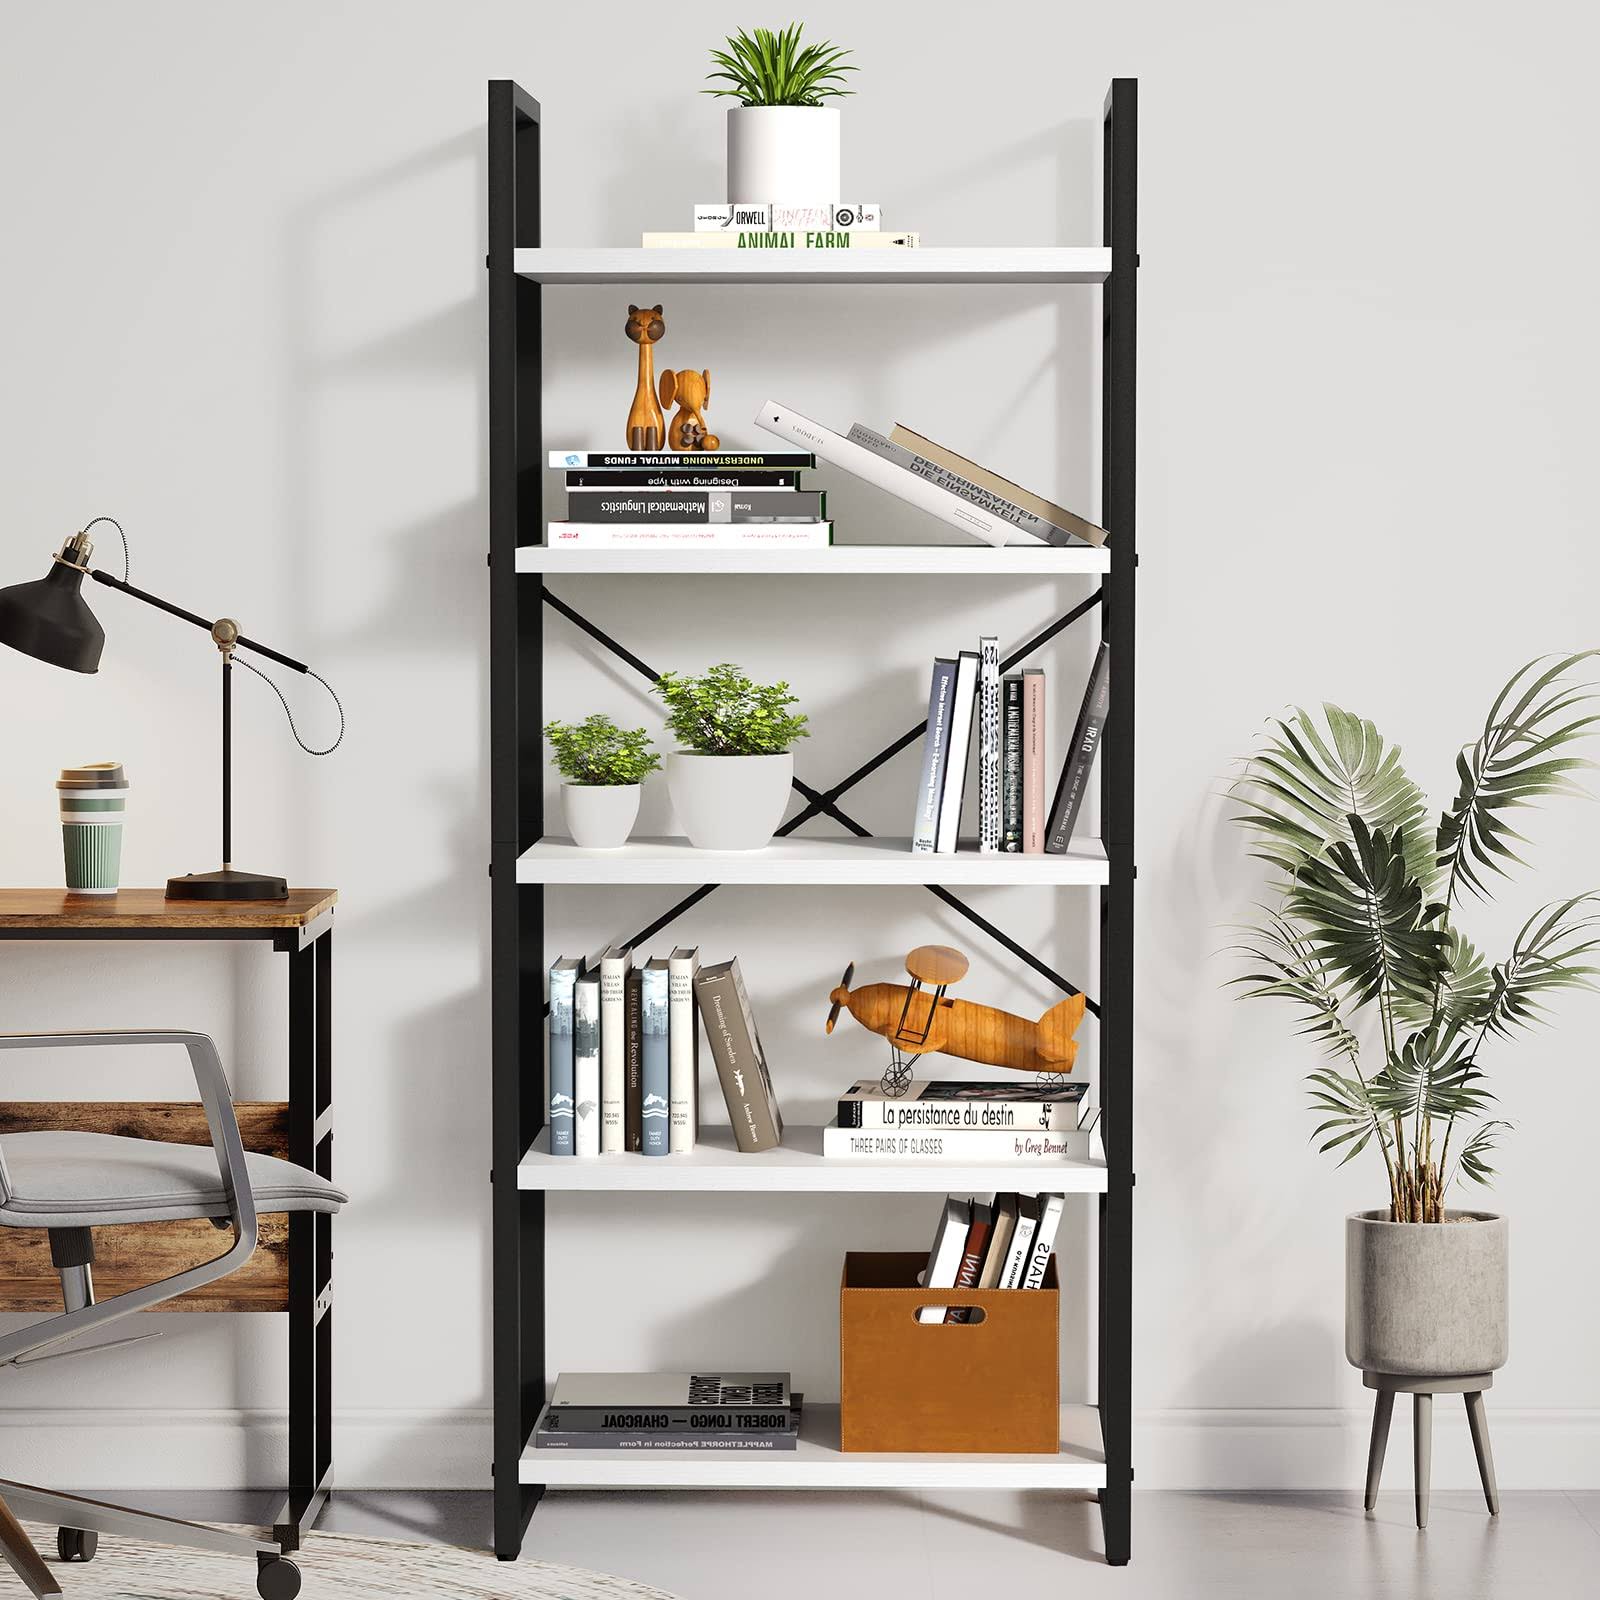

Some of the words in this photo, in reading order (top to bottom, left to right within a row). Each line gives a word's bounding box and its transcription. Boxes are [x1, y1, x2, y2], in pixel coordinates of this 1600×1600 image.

[736, 212, 766, 224] ORWELL
[806, 232, 850, 248] FARM
[604, 456, 636, 465] FUNDS
[640, 456, 680, 465] MUTUAL
[682, 456, 764, 465] UNDERSTANDING
[648, 477, 669, 486] Type
[670, 478, 690, 486] with
[693, 477, 739, 486] Designing
[601, 501, 645, 513] Linguistics
[646, 500, 706, 514] Mathematical
[939, 676, 949, 702] Effective
[936, 702, 945, 726] Internet
[933, 726, 943, 748] Search
[1008, 711, 1020, 751] MATHEMATICAL
[1082, 726, 1098, 752] IRAQ
[928, 752, 940, 788] E-Searching
[1077, 764, 1085, 775] THE
[1072, 776, 1081, 790] LOGIC
[1070, 791, 1076, 800] OF
[713, 994, 726, 1029] Dreaming
[723, 1030, 731, 1040] of
[724, 1037, 736, 1064] Sweden
[883, 1103, 895, 1124] La
[898, 1103, 960, 1128] persistance
[964, 1102, 978, 1125] du
[982, 1103, 1014, 1126] destin
[850, 1138, 873, 1154] THREE
[876, 1138, 896, 1154] PAIRS
[899, 1138, 908, 1154] OF
[910, 1138, 942, 1154] GLASSES
[1014, 1138, 1024, 1156] by
[1025, 1139, 1042, 1156] Greg
[1043, 1140, 1068, 1154] Bennet
